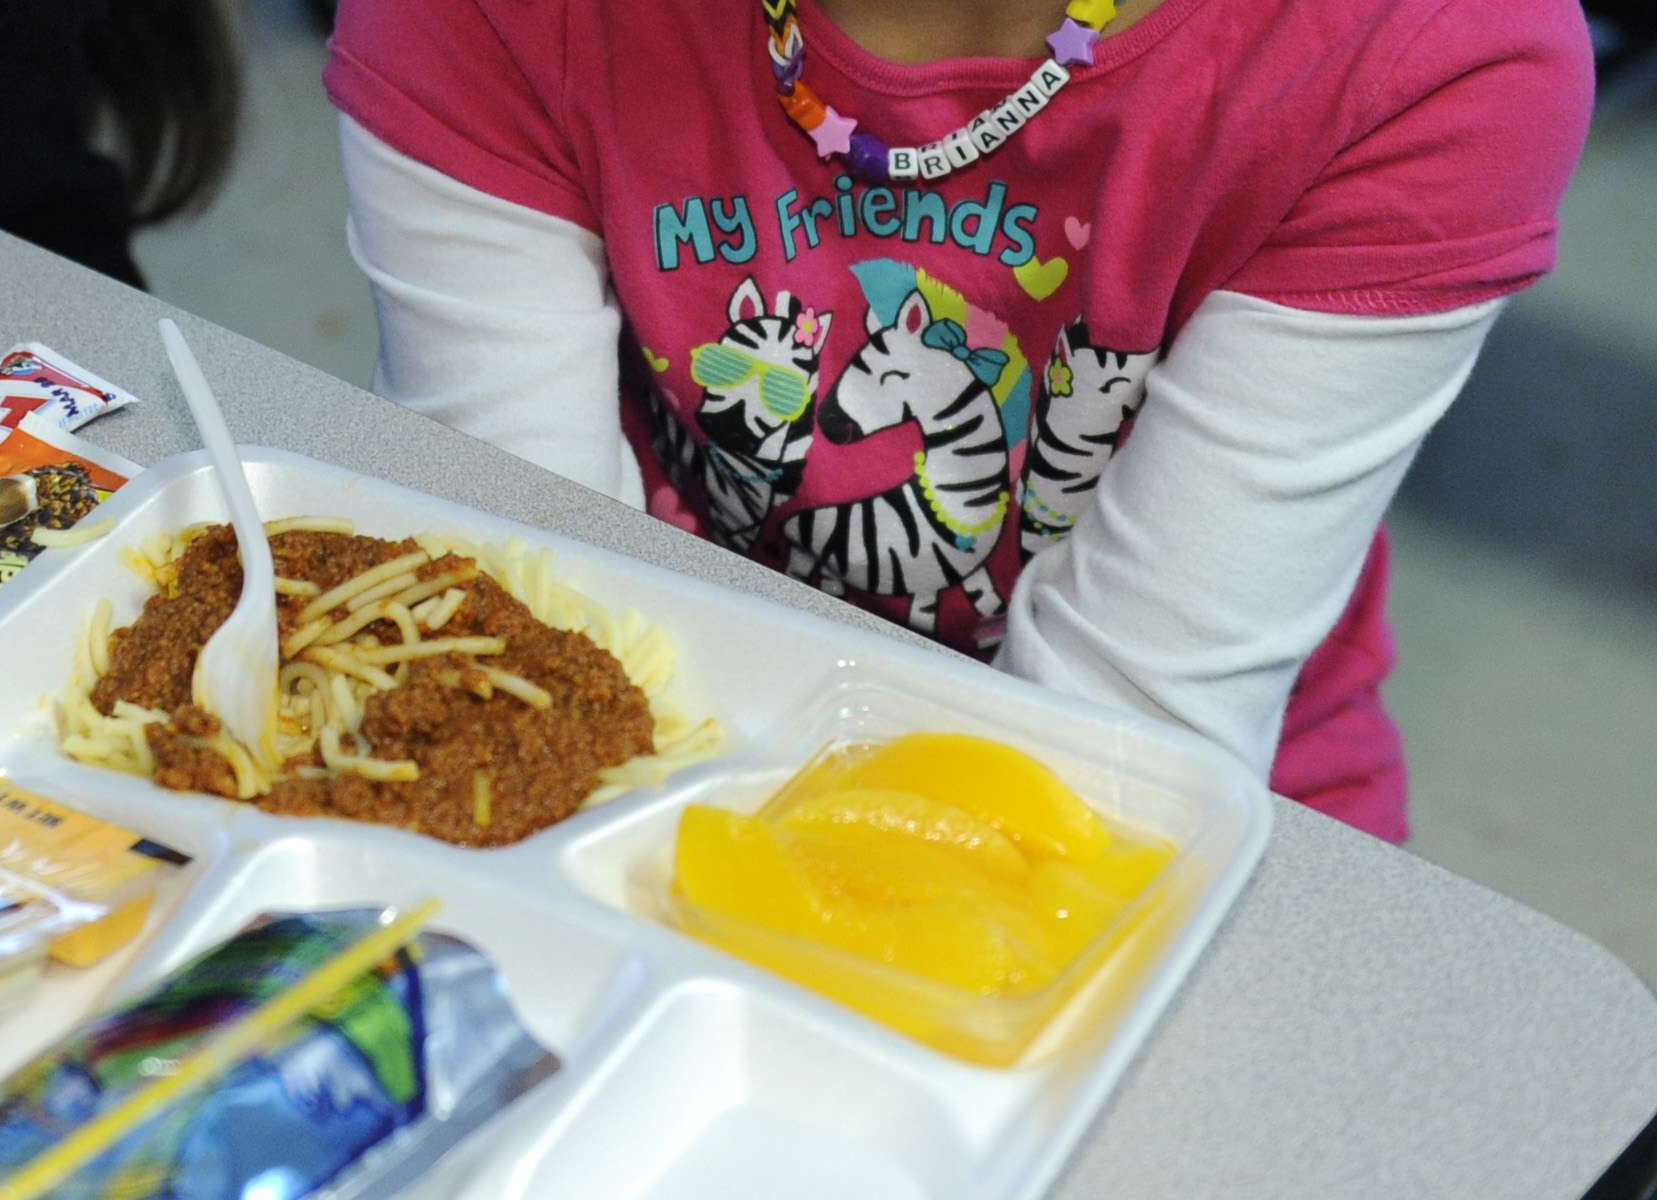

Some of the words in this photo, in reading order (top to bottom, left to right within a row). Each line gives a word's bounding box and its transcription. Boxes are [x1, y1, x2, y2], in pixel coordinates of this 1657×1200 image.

[894, 70, 1062, 175] BRIANNA
[653, 194, 759, 272] My
[775, 174, 1039, 267] Friends
